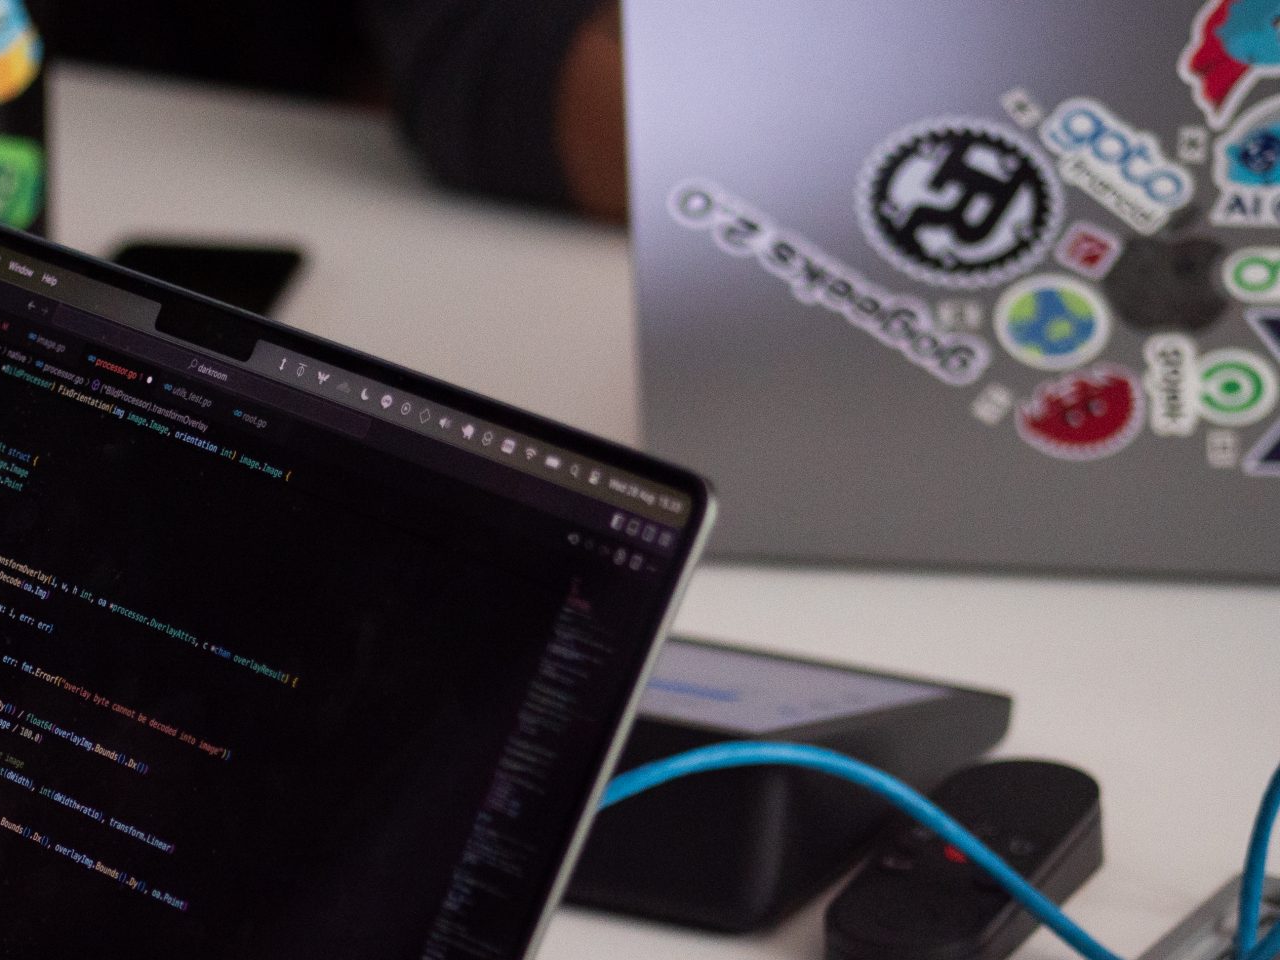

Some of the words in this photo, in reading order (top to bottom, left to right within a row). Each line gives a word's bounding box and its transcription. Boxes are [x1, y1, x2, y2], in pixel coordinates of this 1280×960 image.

[6, 260, 35, 278] Window
[40, 271, 59, 287] Help
[34, 334, 67, 354] image.go
[93, 356, 138, 381] processor.go
[196, 362, 229, 382] darkroom
[170, 384, 213, 409] utils_test.go
[55, 383, 124, 418] FixOrientation(img
[173, 427, 218, 451] orientation
[218, 444, 237, 460] int)
[237, 451, 284, 478] image.Image
[240, 410, 269, 430] root.go
[6, 445, 31, 461] struct
[19, 612, 35, 625] err:
[36, 618, 54, 634] err}
[78, 587, 96, 603] int,
[233, 651, 292, 684] overlayResult)
[2, 654, 18, 666] err:
[92, 692, 111, 708] byte
[111, 700, 137, 718] cannot
[149, 716, 178, 736] decoded
[179, 729, 198, 744] into
